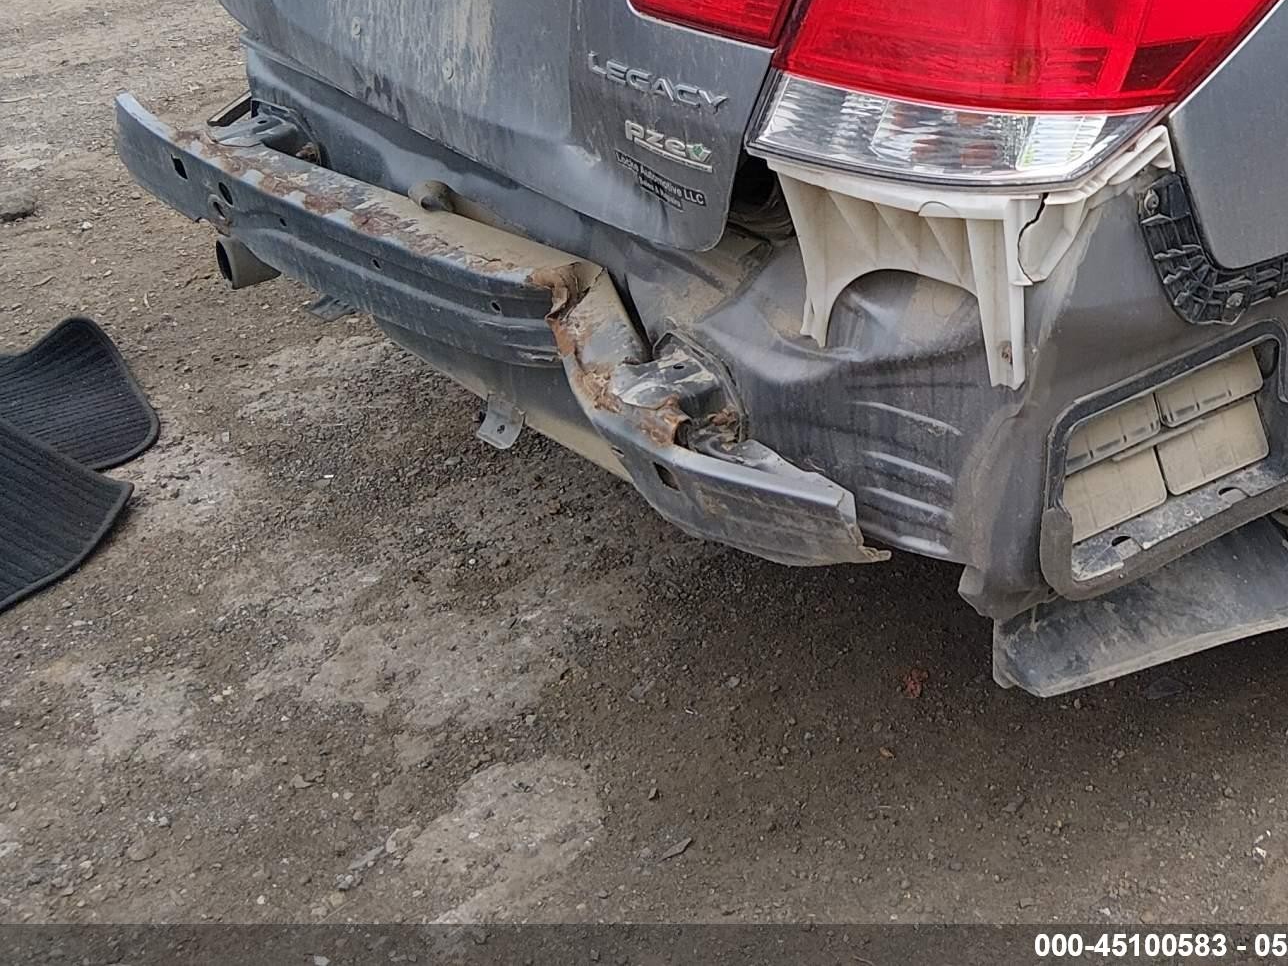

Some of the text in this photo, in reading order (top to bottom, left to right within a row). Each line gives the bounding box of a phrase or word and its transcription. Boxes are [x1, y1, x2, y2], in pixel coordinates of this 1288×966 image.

[588, 51, 728, 114] LEGACY
[640, 164, 683, 197] Automotive
[683, 188, 705, 205] LLC
